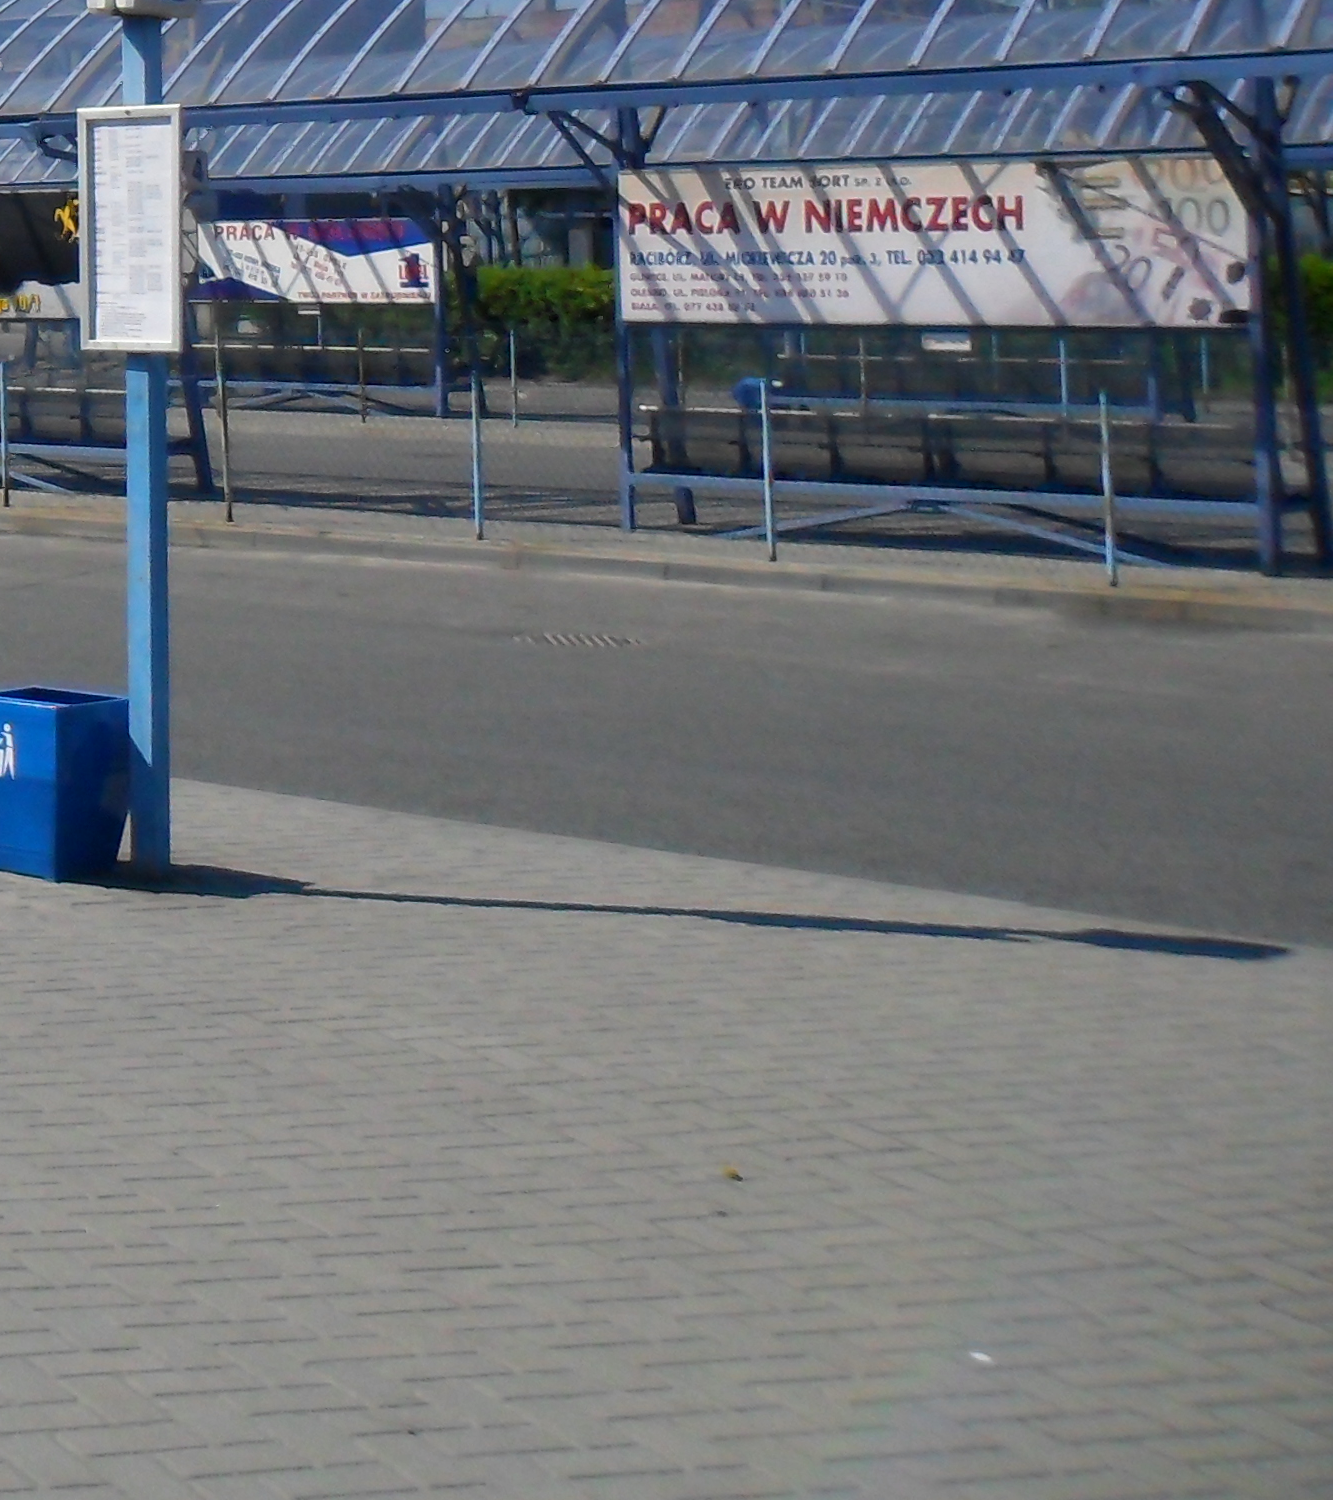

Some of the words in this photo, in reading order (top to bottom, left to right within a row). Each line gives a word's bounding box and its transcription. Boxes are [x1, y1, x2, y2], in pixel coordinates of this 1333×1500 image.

[761, 176, 804, 190] TEAM
[628, 200, 741, 236] PRACA
[751, 199, 791, 235] W
[804, 195, 1025, 234] NIEMCZECH
[214, 224, 277, 242] PRACA
[820, 249, 837, 266] 20
[885, 250, 913, 266] TEL.
[949, 248, 979, 265] 414
